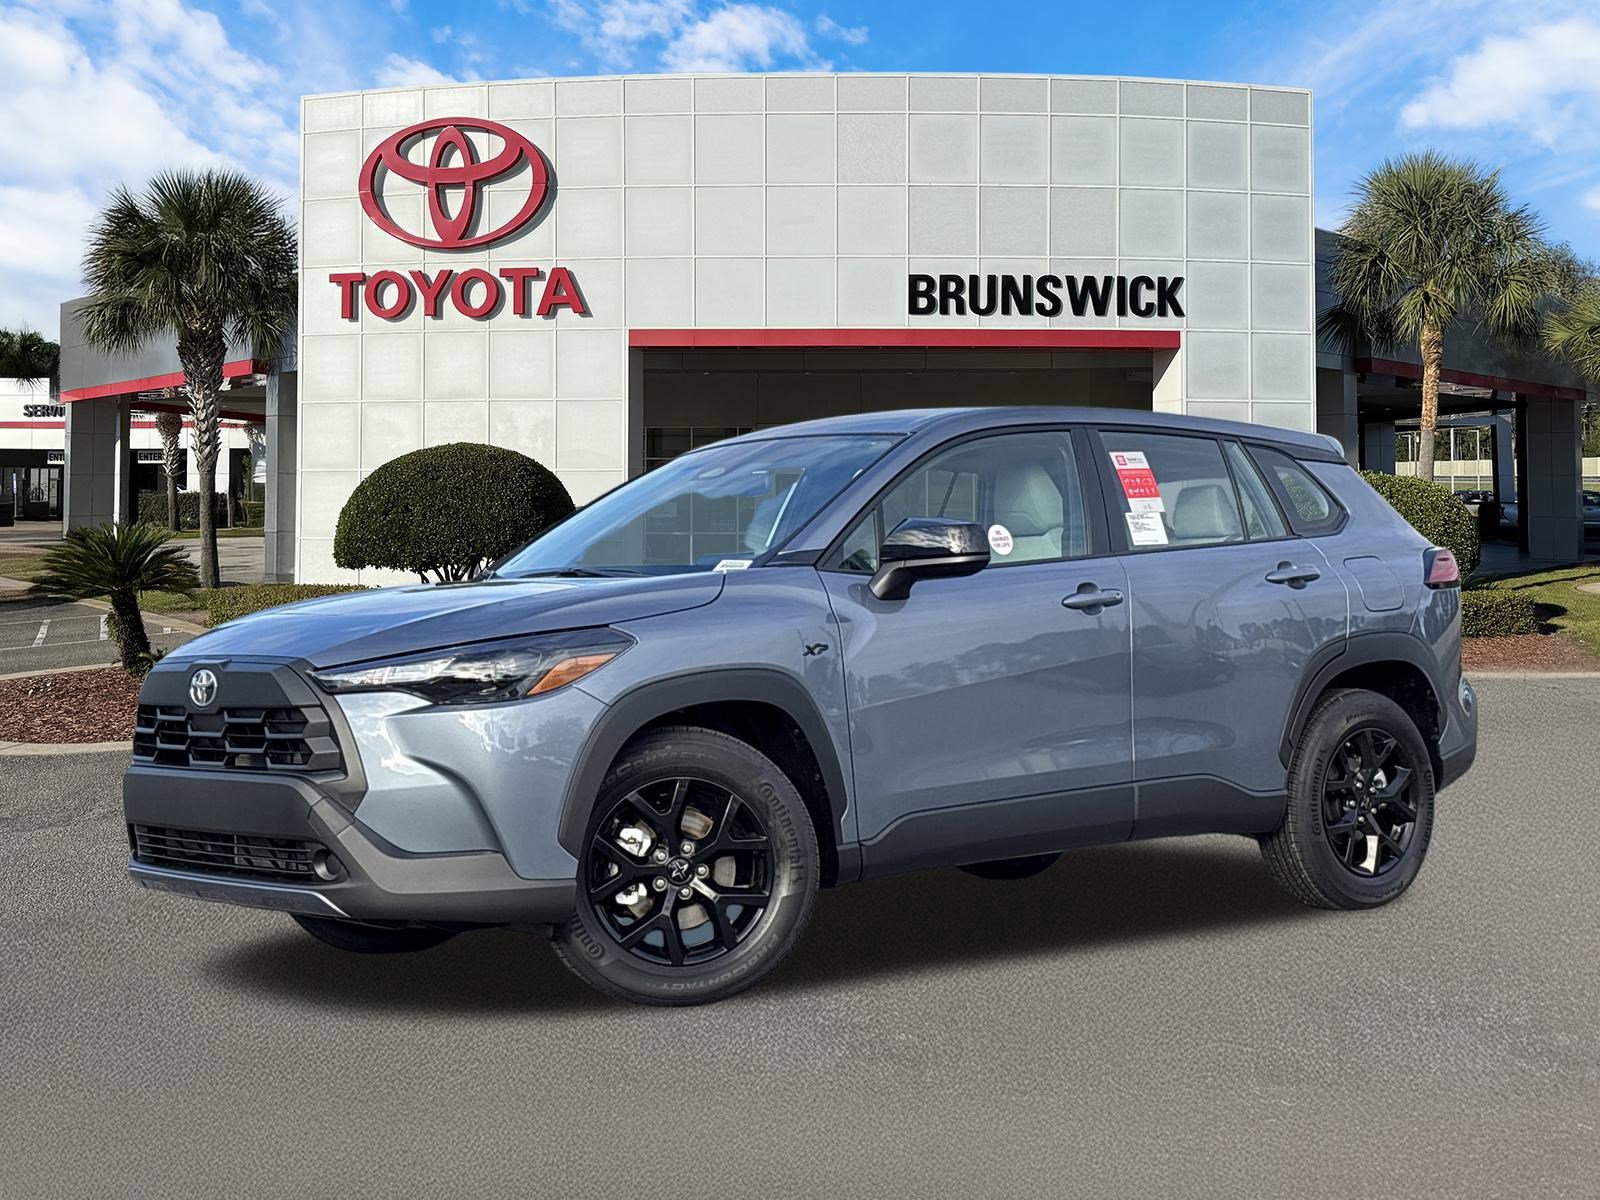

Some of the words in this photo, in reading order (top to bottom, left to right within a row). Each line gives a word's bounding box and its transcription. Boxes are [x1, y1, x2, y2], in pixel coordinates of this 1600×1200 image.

[329, 267, 587, 319] TOYOTA
[908, 274, 1185, 318] BRUNSWICK
[48, 453, 65, 462] ENT
[760, 782, 804, 869] Continental
